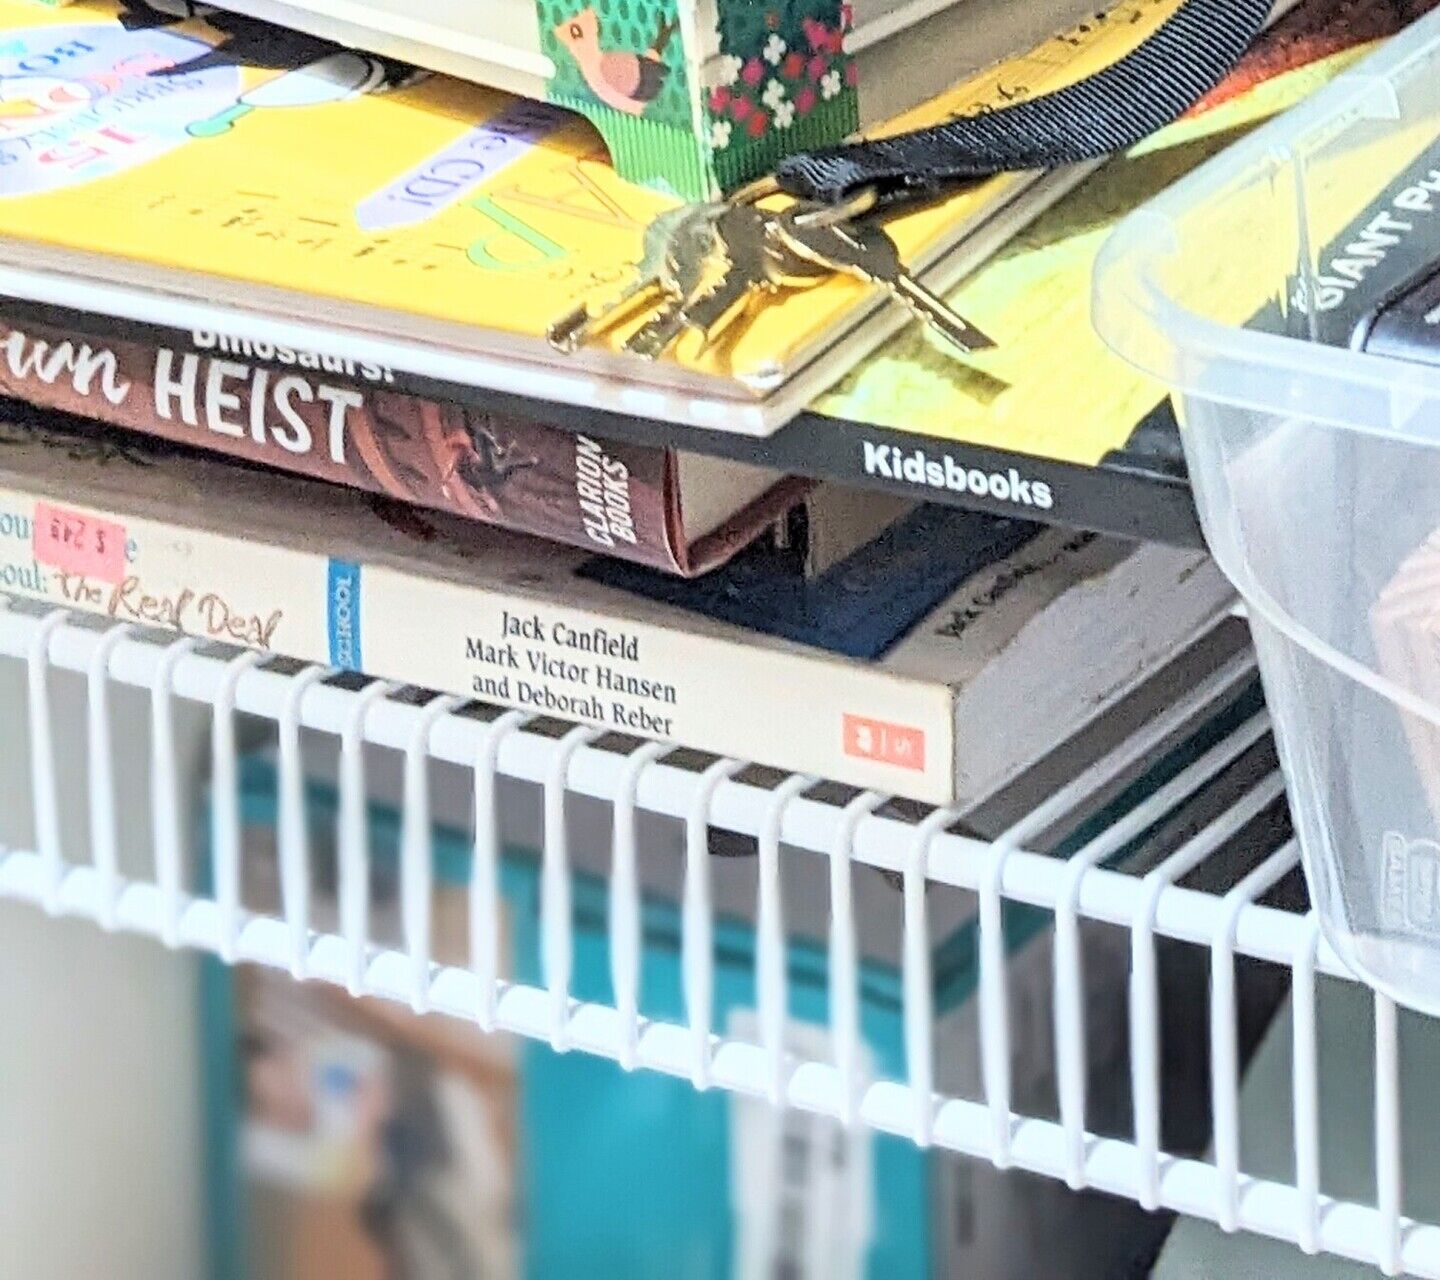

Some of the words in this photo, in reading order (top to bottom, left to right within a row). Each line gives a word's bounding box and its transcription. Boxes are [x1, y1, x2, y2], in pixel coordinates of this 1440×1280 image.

[1291, 210, 1413, 315] GIANT
[155, 348, 363, 464] HEIST
[576, 433, 615, 548] CLARION
[602, 454, 637, 545] BOOKS
[863, 440, 1053, 509] Kidsbooks
[54, 569, 102, 604] The
[108, 576, 195, 634] Real
[198, 592, 284, 649] Deal
[502, 610, 546, 640] Jack
[552, 621, 640, 662] Canfield
[465, 637, 520, 670] Mark
[527, 649, 590, 685] Victor
[595, 664, 678, 705] Hansen
[472, 674, 511, 700] and
[516, 680, 605, 722] Deborah
[611, 702, 674, 737] Reber
